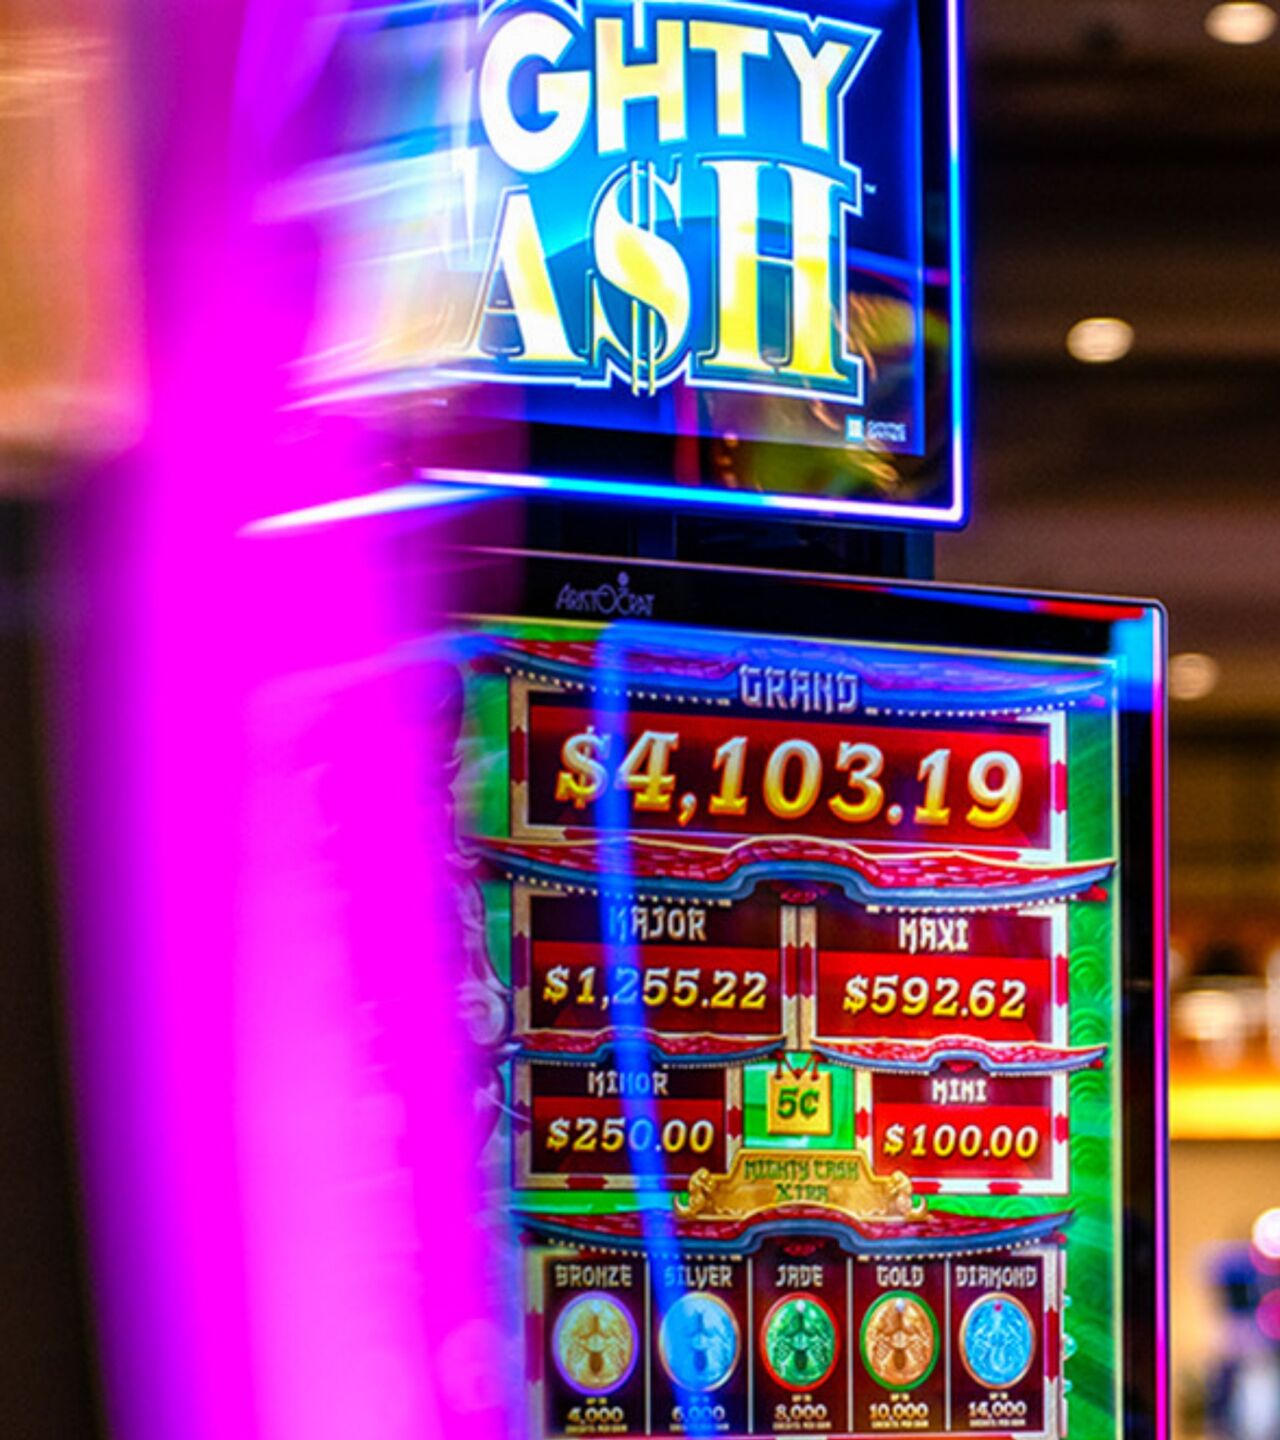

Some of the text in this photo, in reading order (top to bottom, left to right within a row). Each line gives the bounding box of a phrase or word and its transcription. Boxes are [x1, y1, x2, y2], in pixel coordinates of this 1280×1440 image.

[480, 12, 852, 174] GHTY
[738, 664, 859, 713] GRAND
[555, 725, 1022, 829] $4,103.19
[609, 905, 707, 942] MAJOR
[899, 917, 969, 954] MAXI
[543, 964, 769, 1010] $1,255.22
[843, 974, 1027, 1019] $592.62
[587, 1070, 668, 1098] MINOR
[932, 1079, 987, 1105] MINI
[546, 1116, 714, 1153] $250.00
[884, 1123, 1039, 1158] $100.00
[555, 1264, 632, 1288] BRONZE
[664, 1264, 732, 1288] SILVER
[775, 1264, 823, 1287] JADE
[876, 1264, 925, 1287] GOLD
[955, 1264, 1038, 1288] DIAMOND
[774, 1403, 828, 1423] 8,000
[868, 1402, 929, 1422] 10,000
